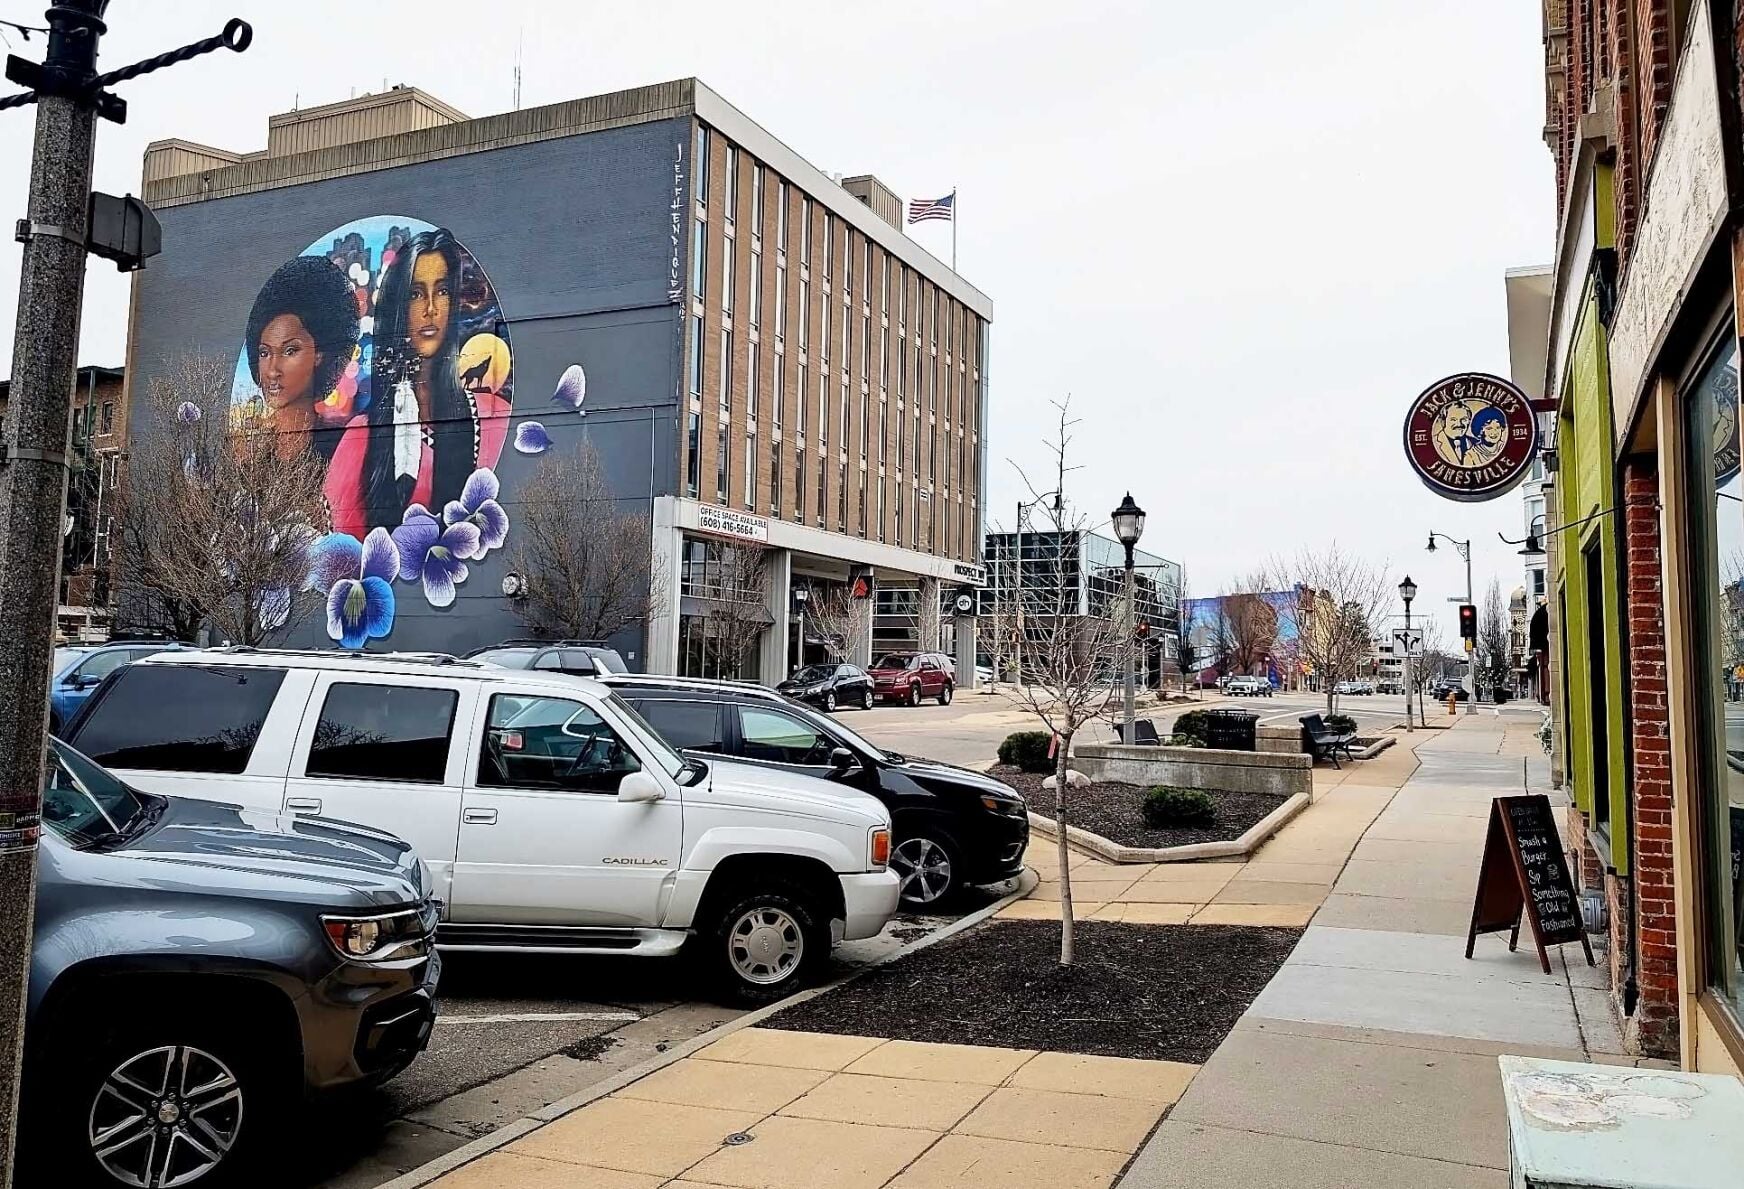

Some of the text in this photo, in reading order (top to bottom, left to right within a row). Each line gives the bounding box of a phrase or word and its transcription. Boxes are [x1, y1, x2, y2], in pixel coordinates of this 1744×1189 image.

[1420, 381, 1521, 418] JACK & JENNY'S
[1414, 434, 1428, 442] EST.
[1512, 428, 1528, 437] 1934
[701, 506, 767, 529] OFFICE SPACE AVAILABLE
[700, 516, 753, 535] (608) 416-5664
[1518, 834, 1541, 848] Smash
[602, 857, 668, 866] CADILLAC
[1528, 869, 1541, 885] Sip
[1532, 885, 1570, 903] Something
[1545, 900, 1560, 913] Old
